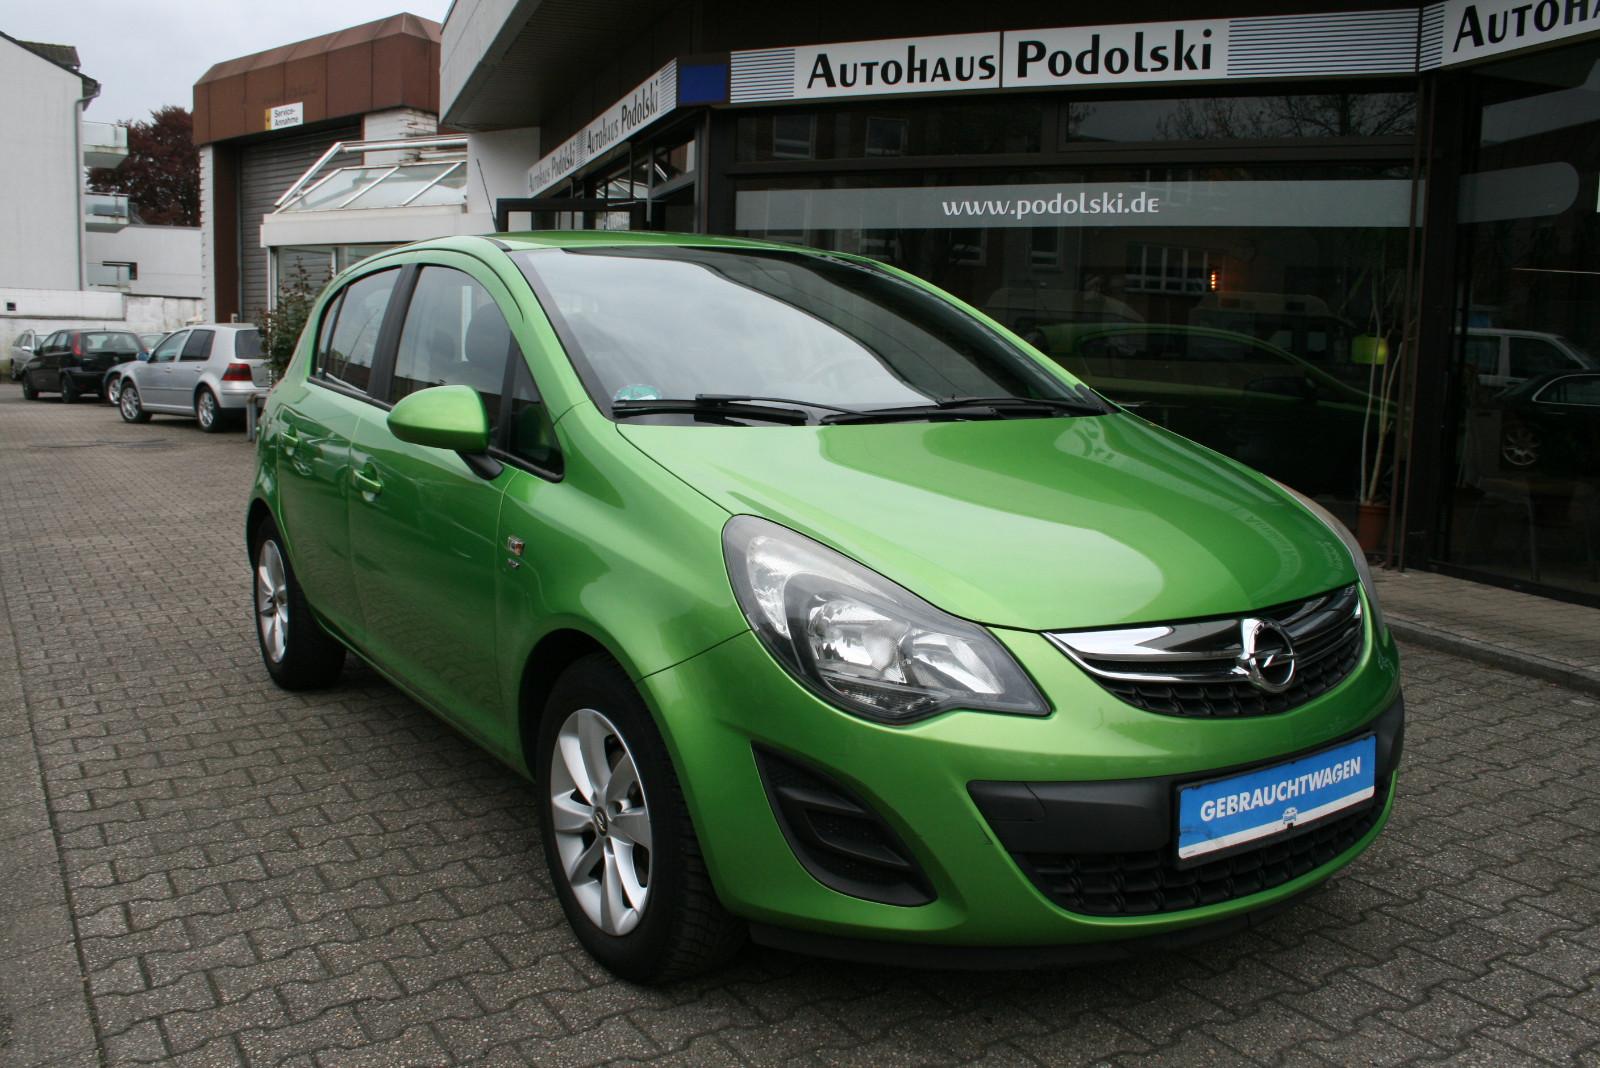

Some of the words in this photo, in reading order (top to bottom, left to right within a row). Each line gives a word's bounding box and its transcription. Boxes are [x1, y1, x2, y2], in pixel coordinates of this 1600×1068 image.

[1017, 28, 1213, 78] Podolski
[274, 116, 299, 127] Annahme
[621, 80, 658, 135] Podolski
[551, 141, 576, 180] Podolski
[1200, 756, 1361, 822] GEBRAUCHTWAGEN
